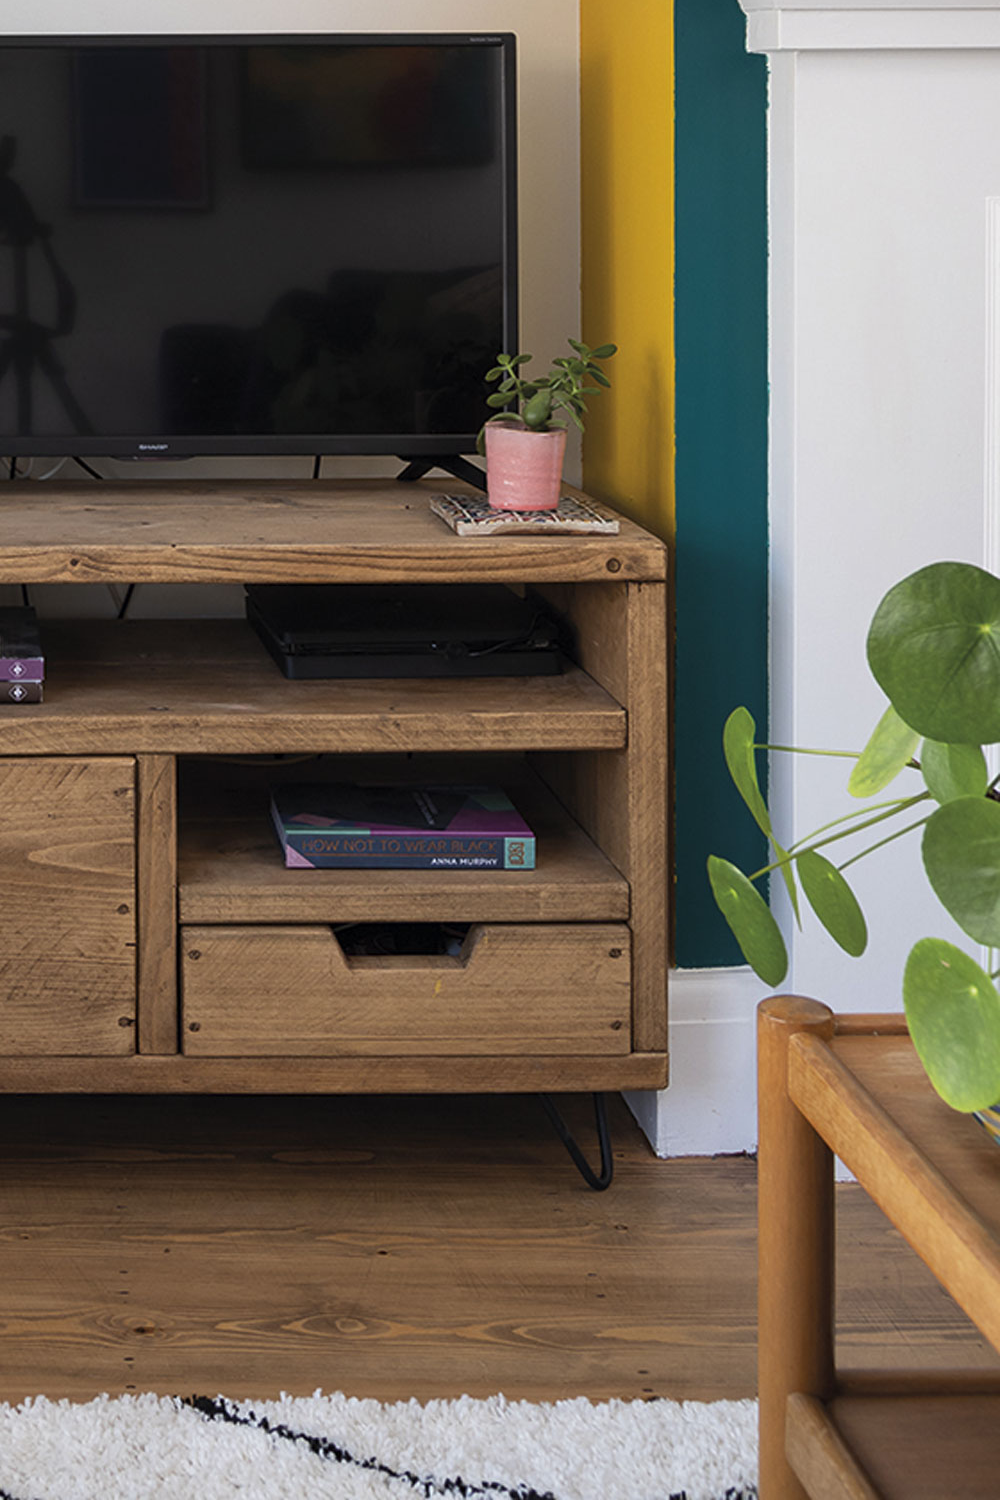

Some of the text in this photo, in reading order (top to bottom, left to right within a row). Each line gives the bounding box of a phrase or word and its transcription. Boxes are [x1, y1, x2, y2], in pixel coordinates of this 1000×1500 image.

[302, 839, 498, 852] HOW NOT TO WEAR BLACK
[431, 857, 498, 866] ANNA MURPHY
